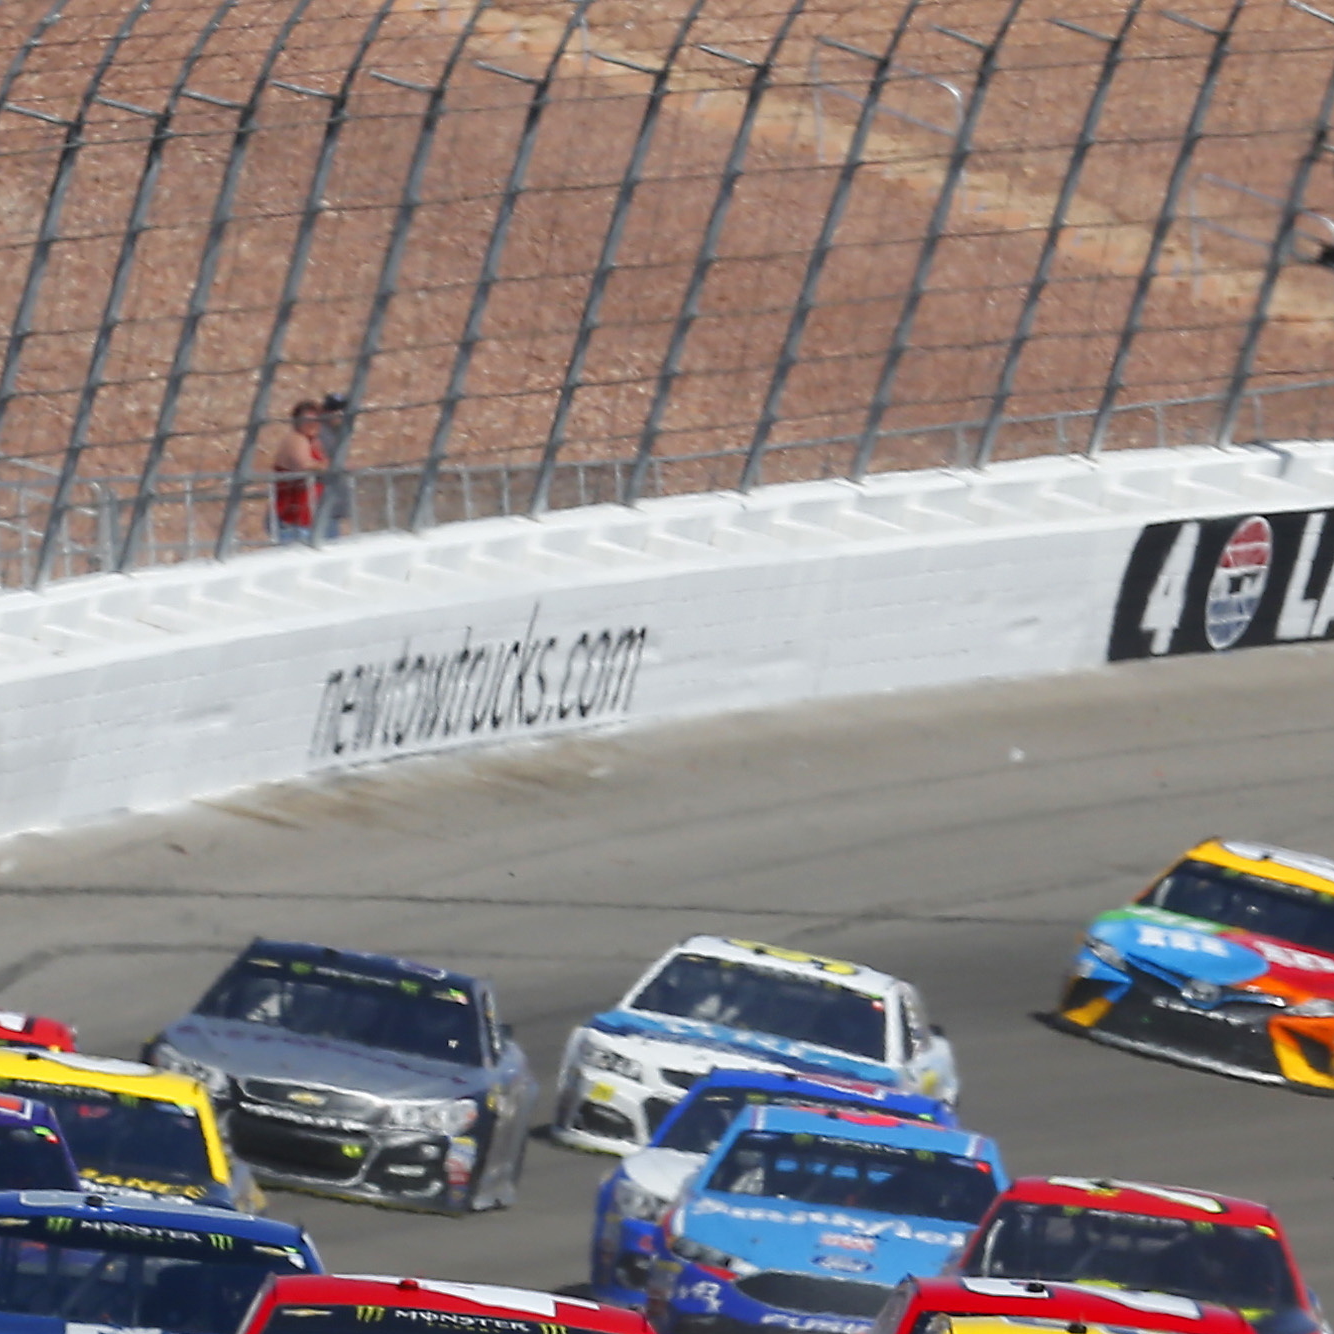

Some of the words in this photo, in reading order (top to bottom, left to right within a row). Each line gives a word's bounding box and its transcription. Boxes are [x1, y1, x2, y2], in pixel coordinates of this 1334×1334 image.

[1140, 522, 1201, 656] 4
[79, 1219, 203, 1243] MONSTER
[394, 1309, 530, 1332] MONSTER
